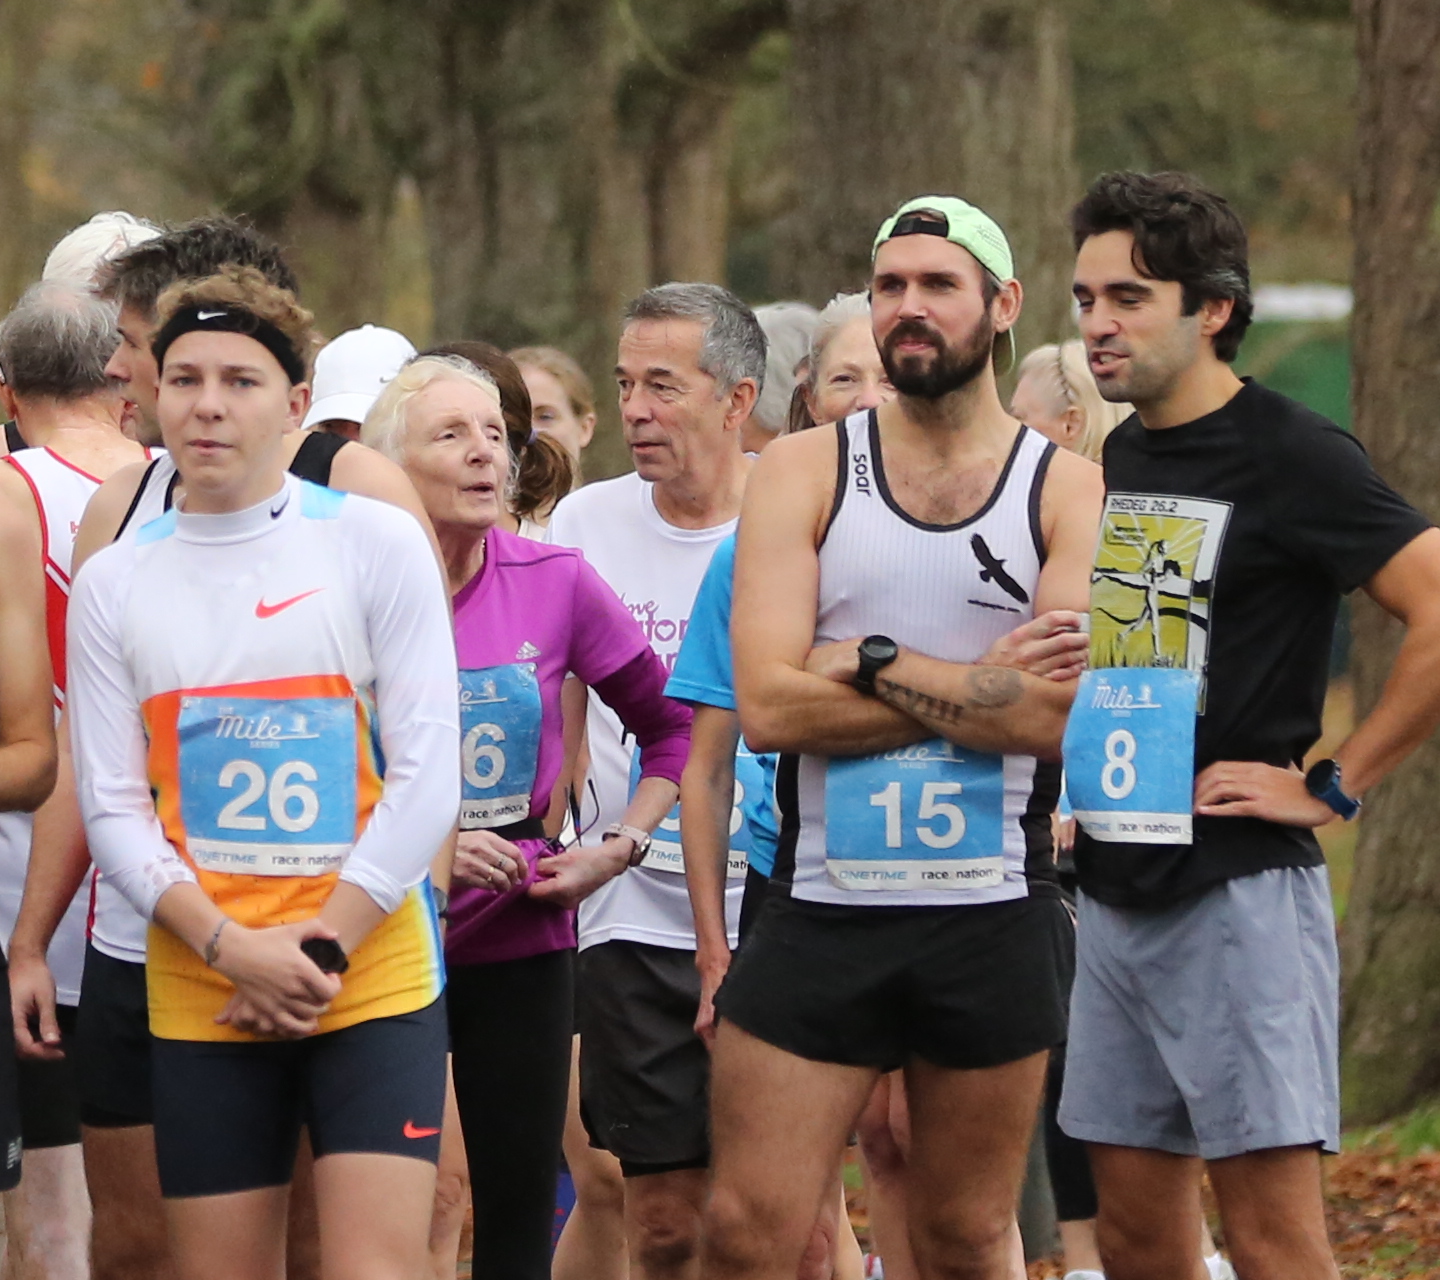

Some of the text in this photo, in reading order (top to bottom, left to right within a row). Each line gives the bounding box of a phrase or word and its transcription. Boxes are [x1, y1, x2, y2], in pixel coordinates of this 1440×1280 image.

[853, 453, 871, 498] soar
[1151, 500, 1178, 513] 26.2
[1092, 685, 1161, 709] Mile
[216, 716, 319, 740] Mile
[1101, 729, 1137, 800] 8
[217, 759, 319, 833] 26
[463, 807, 488, 819] race
[870, 781, 966, 849] 15
[1145, 822, 1181, 835] nation
[272, 855, 300, 866] race
[650, 848, 682, 863] TIME
[839, 867, 993, 881] ONETIME race nation
